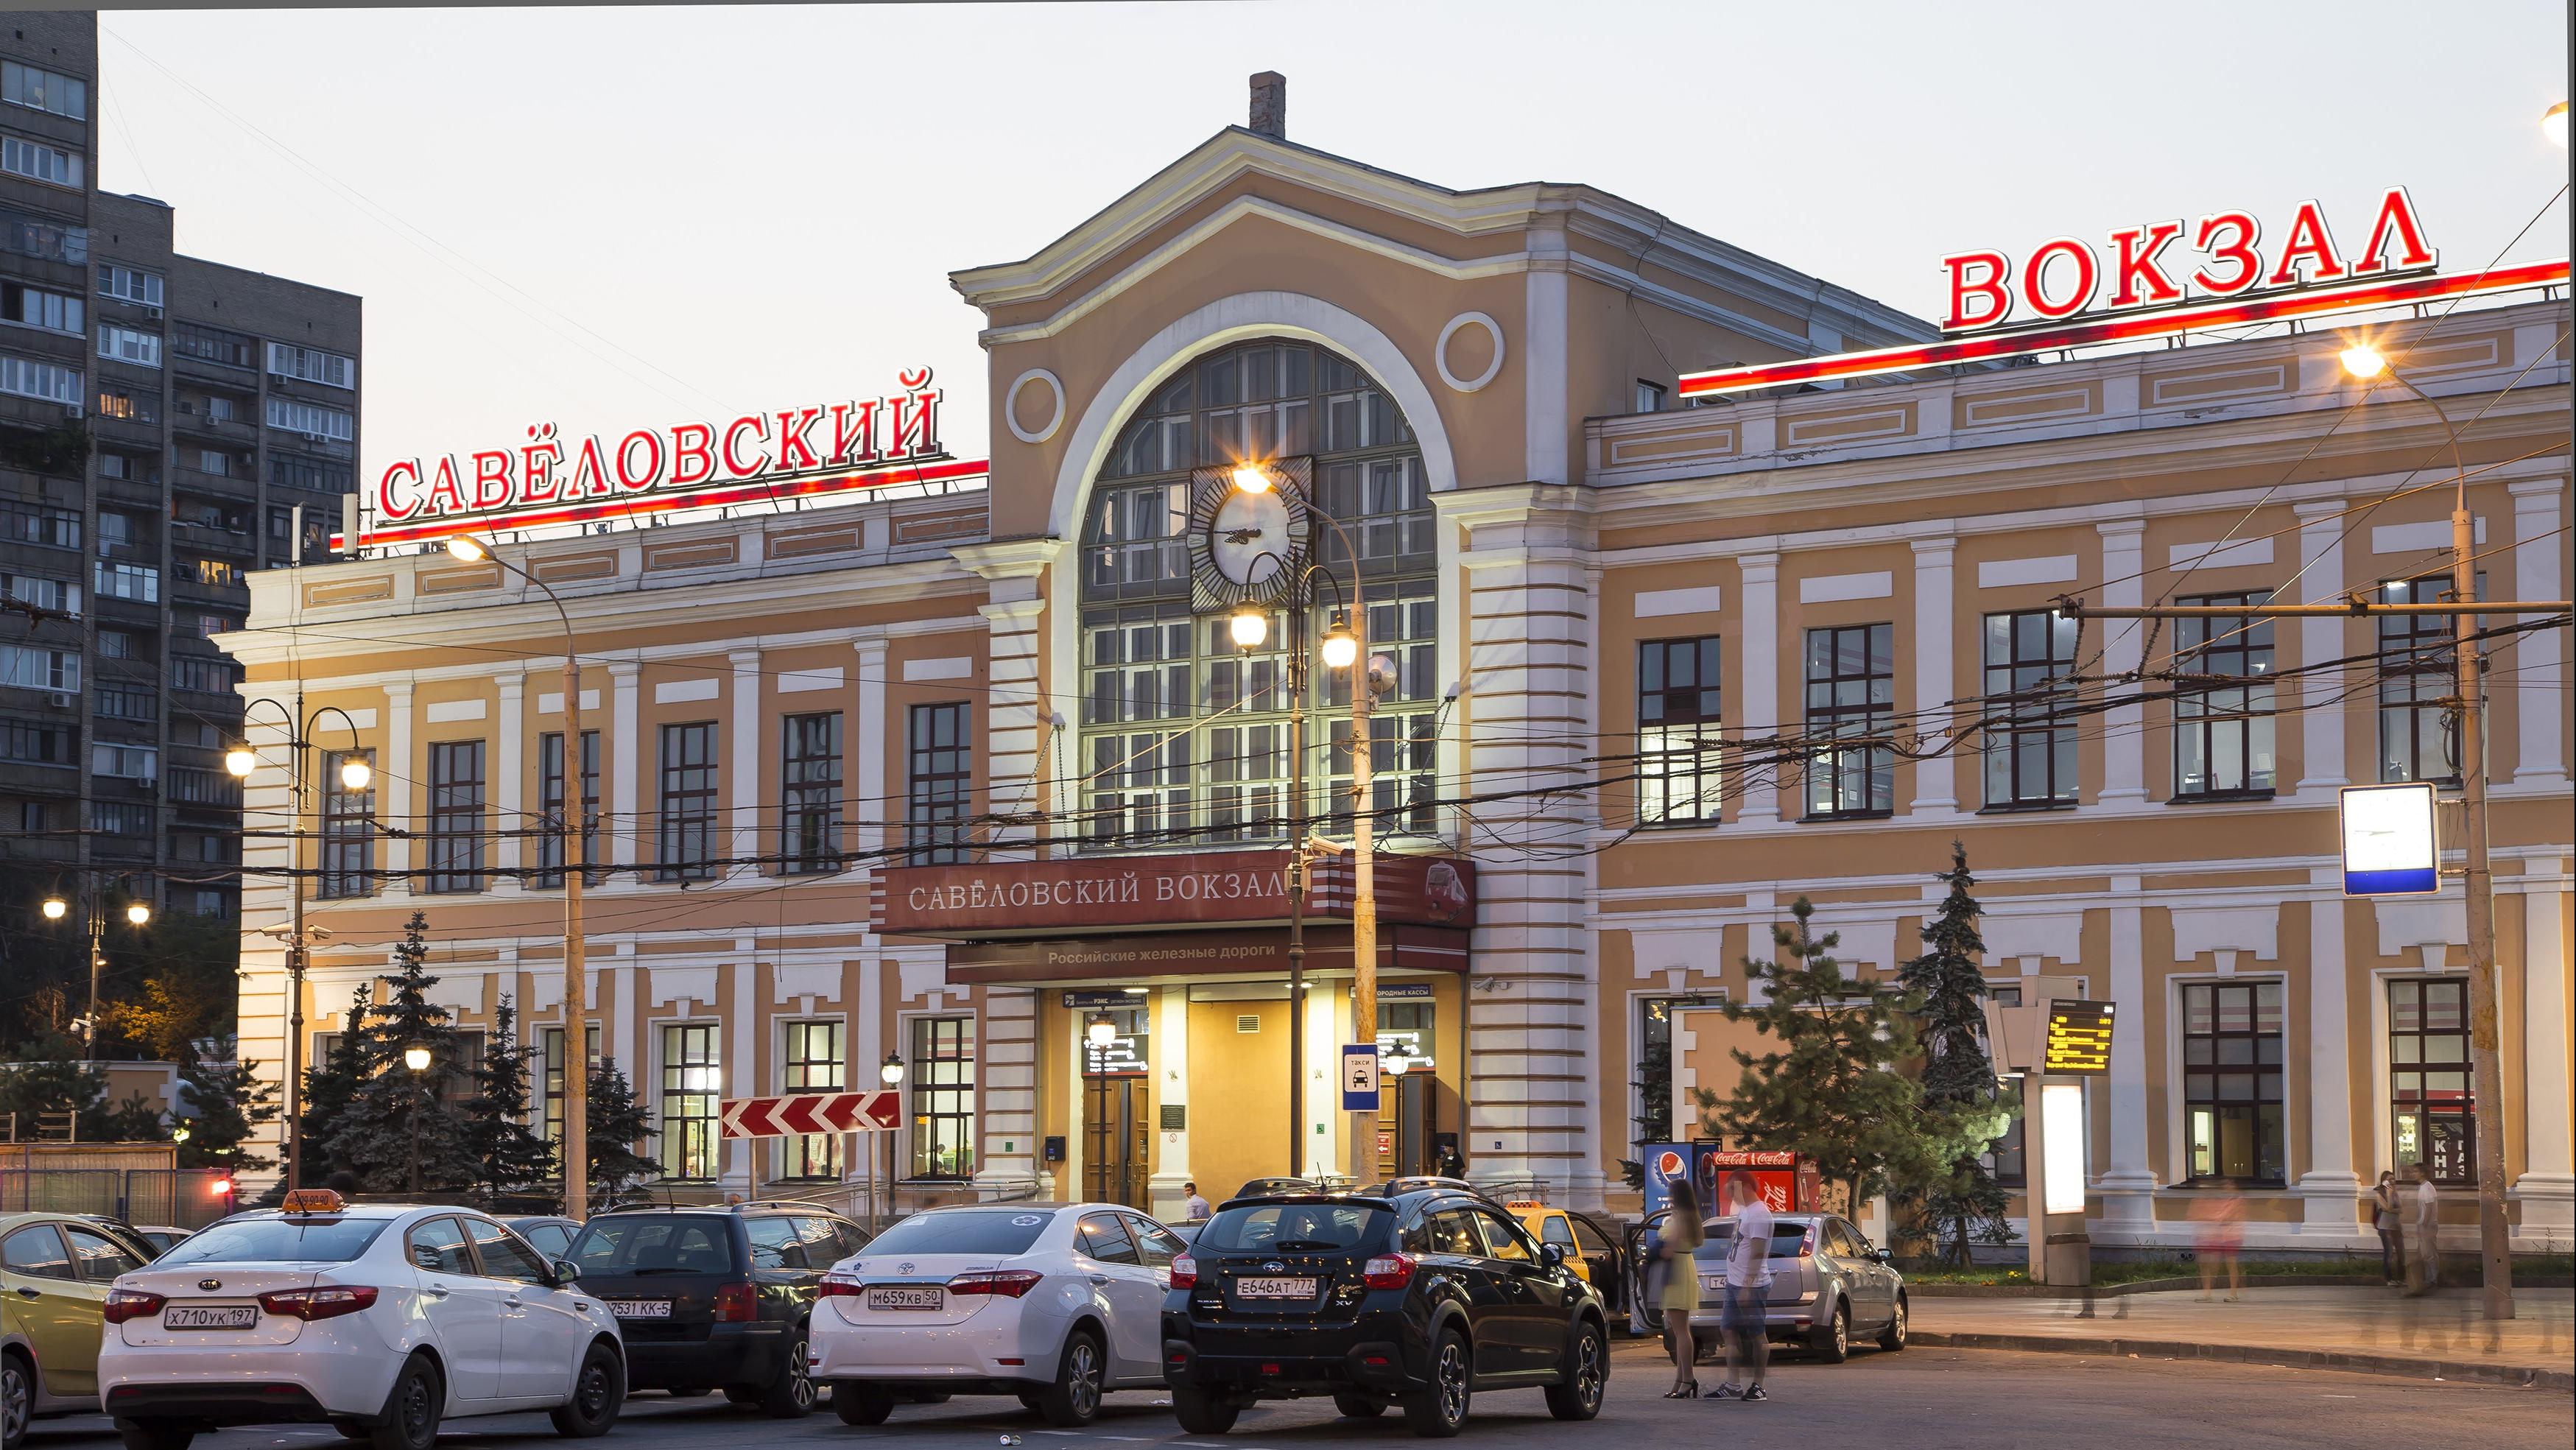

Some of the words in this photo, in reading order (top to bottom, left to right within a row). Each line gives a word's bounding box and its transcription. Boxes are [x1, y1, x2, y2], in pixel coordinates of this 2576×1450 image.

[1940, 186, 2438, 333] ВОКЗАЛ
[378, 365, 943, 521] САВЁЛОВСКИЙ
[909, 872, 1140, 911] САВЁЛОВСКИЙ
[1155, 872, 1285, 901] ВОКЗАЛ
[1048, 951, 1136, 964] Российские
[1140, 946, 1217, 960] железные
[1220, 945, 1275, 959] дороги
